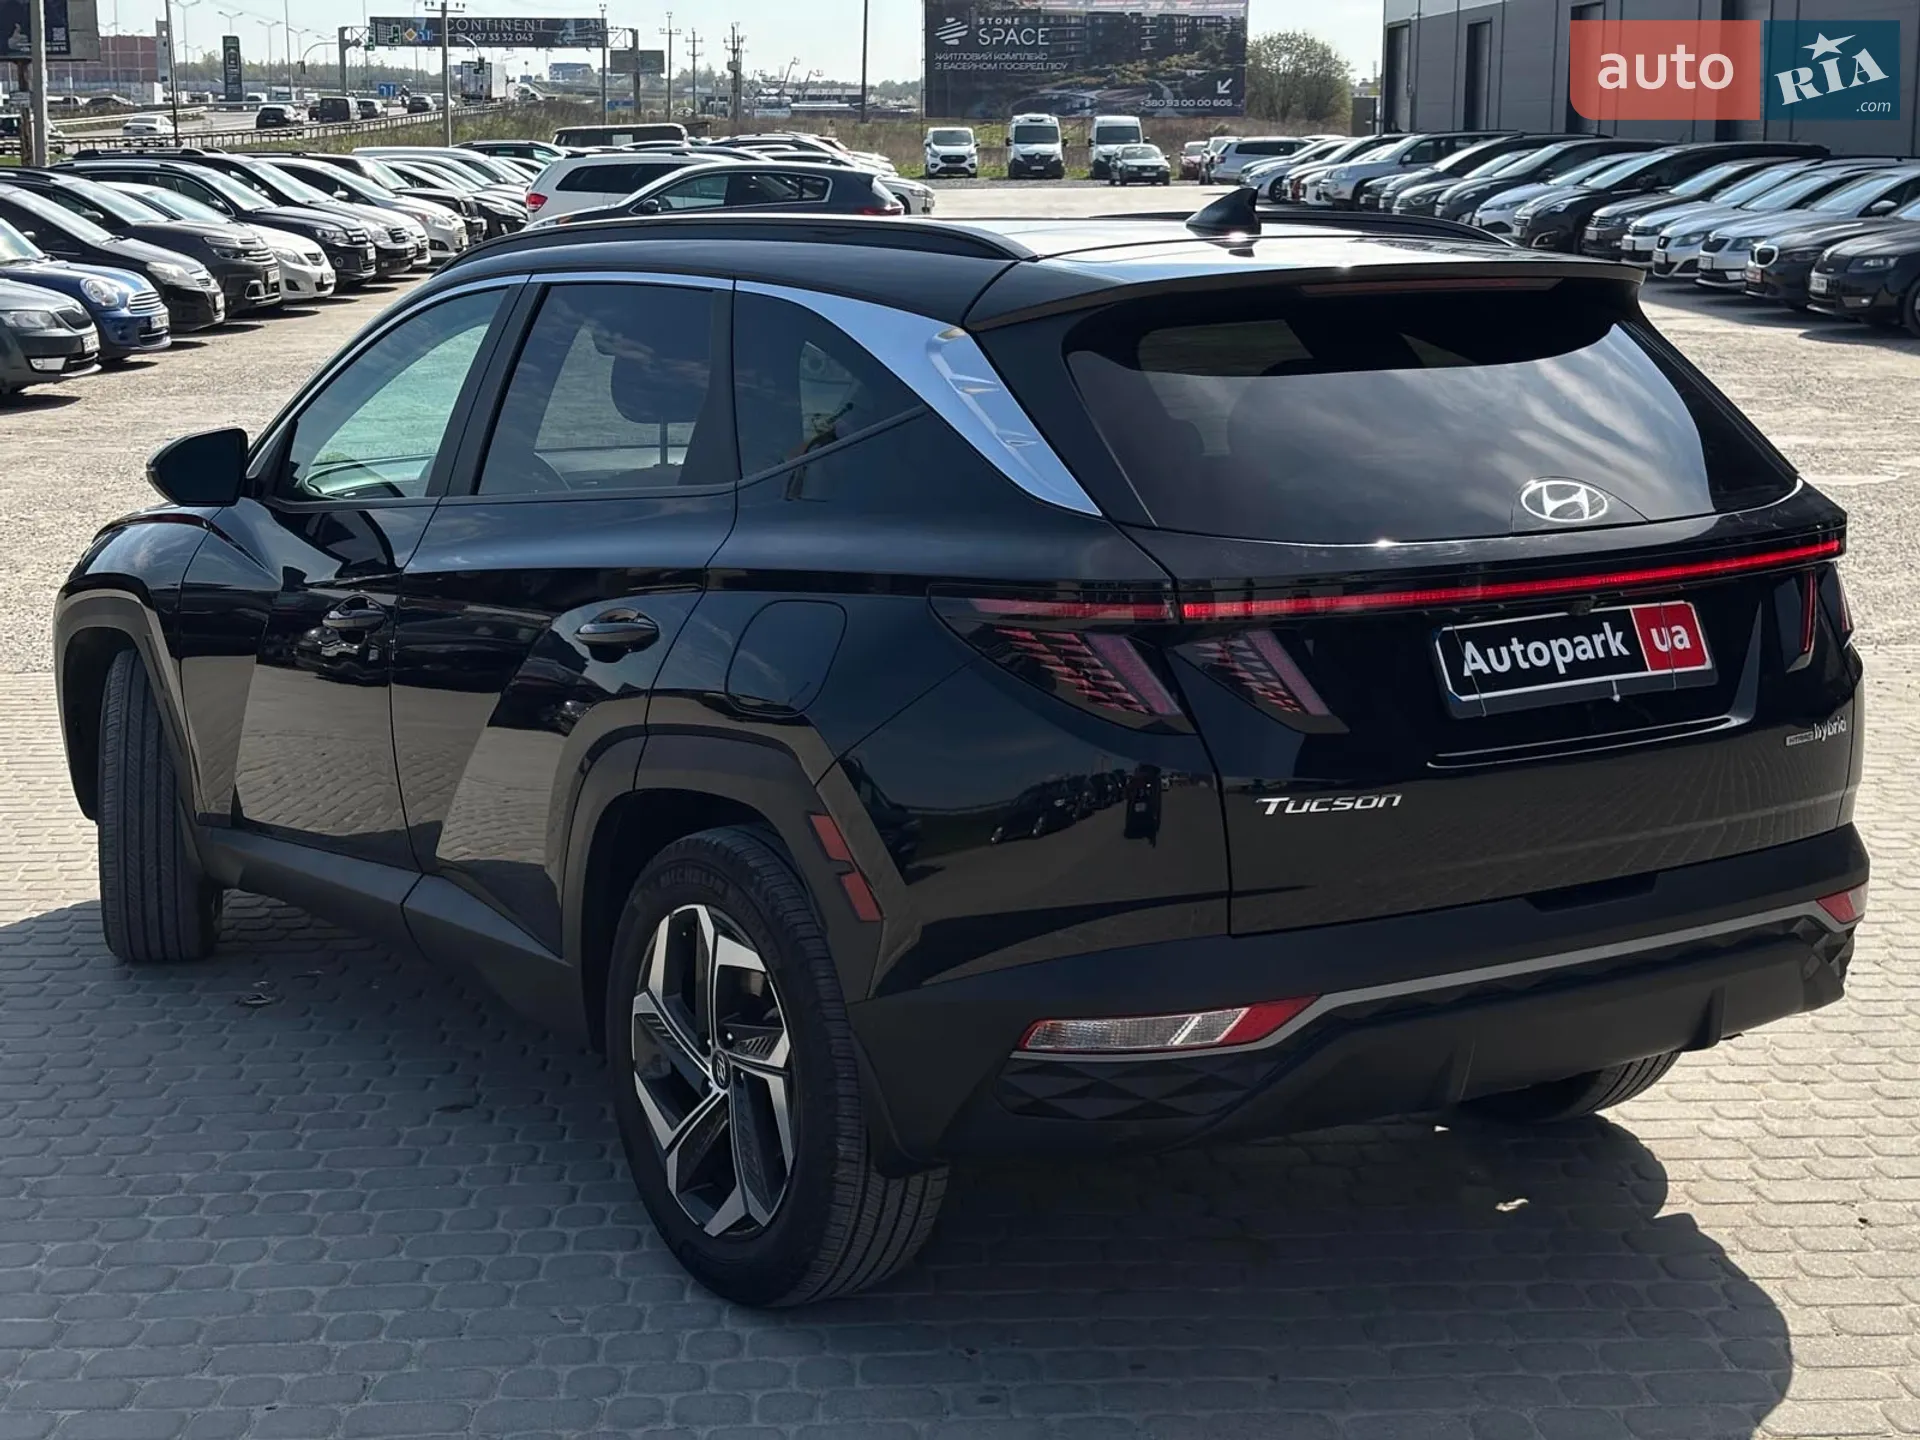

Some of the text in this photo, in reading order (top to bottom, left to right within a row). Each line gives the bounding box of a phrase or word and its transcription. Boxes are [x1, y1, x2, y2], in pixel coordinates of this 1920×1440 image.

[447, 19, 545, 31] CONTINENT
[469, 33, 534, 42] 067 33 32 043
[978, 28, 1050, 45] SPACE
[935, 52, 992, 60] ЖИТЛОВИЙ
[943, 62, 998, 70] БАСЕЙНОМ
[1462, 622, 1691, 676] Autopark ua
[1814, 716, 1847, 742] hybrid
